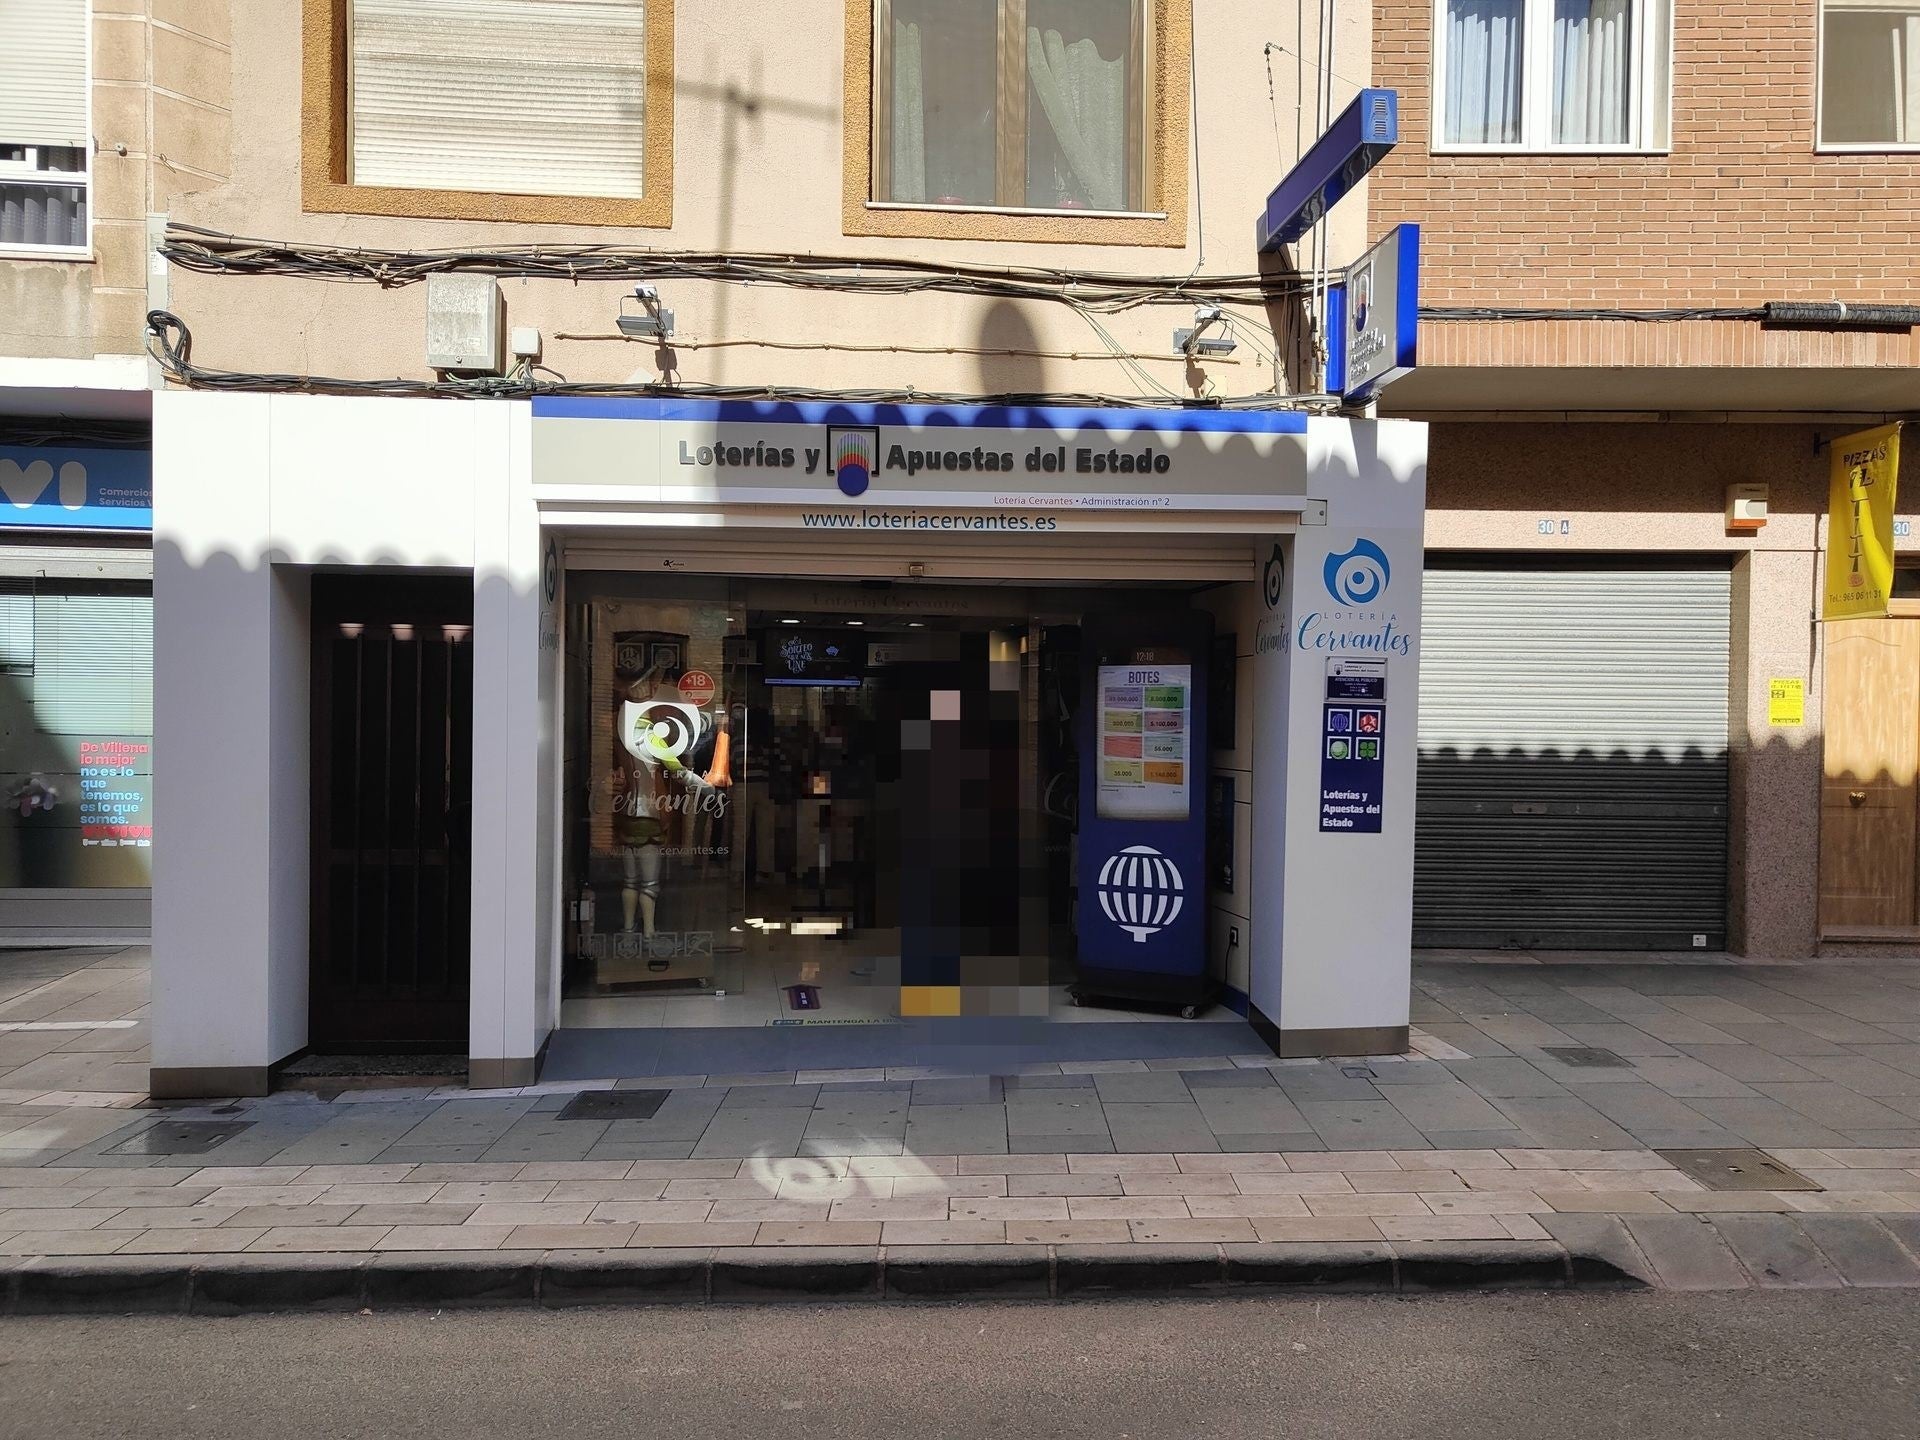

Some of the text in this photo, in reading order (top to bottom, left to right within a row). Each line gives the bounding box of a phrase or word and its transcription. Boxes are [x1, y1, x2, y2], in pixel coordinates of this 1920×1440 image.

[678, 440, 1171, 476] Loterías y Apuestas del Estado
[1843, 445, 1887, 466] PIZZAS
[98, 497, 146, 507] Servicios
[1029, 496, 1074, 506] Cervantes
[1081, 496, 1149, 506] Administración
[1164, 497, 1170, 506] 2
[802, 509, 1057, 530] www.loteriacervantes.es
[1539, 520, 1569, 534] 30 A
[1298, 612, 1414, 656] Cervantes
[686, 675, 705, 686] +18
[1128, 671, 1160, 684] BOTES
[80, 741, 149, 753] De Villena
[80, 754, 136, 768] lo mejor
[80, 766, 134, 776] no es lo
[80, 779, 107, 791] que
[80, 790, 144, 802] tenemos,
[1323, 789, 1368, 802] Loterías y
[80, 802, 139, 815] es lo que
[1322, 803, 1380, 815] Apuestas del
[80, 815, 129, 825] somos.
[1322, 817, 1353, 827] Estado
